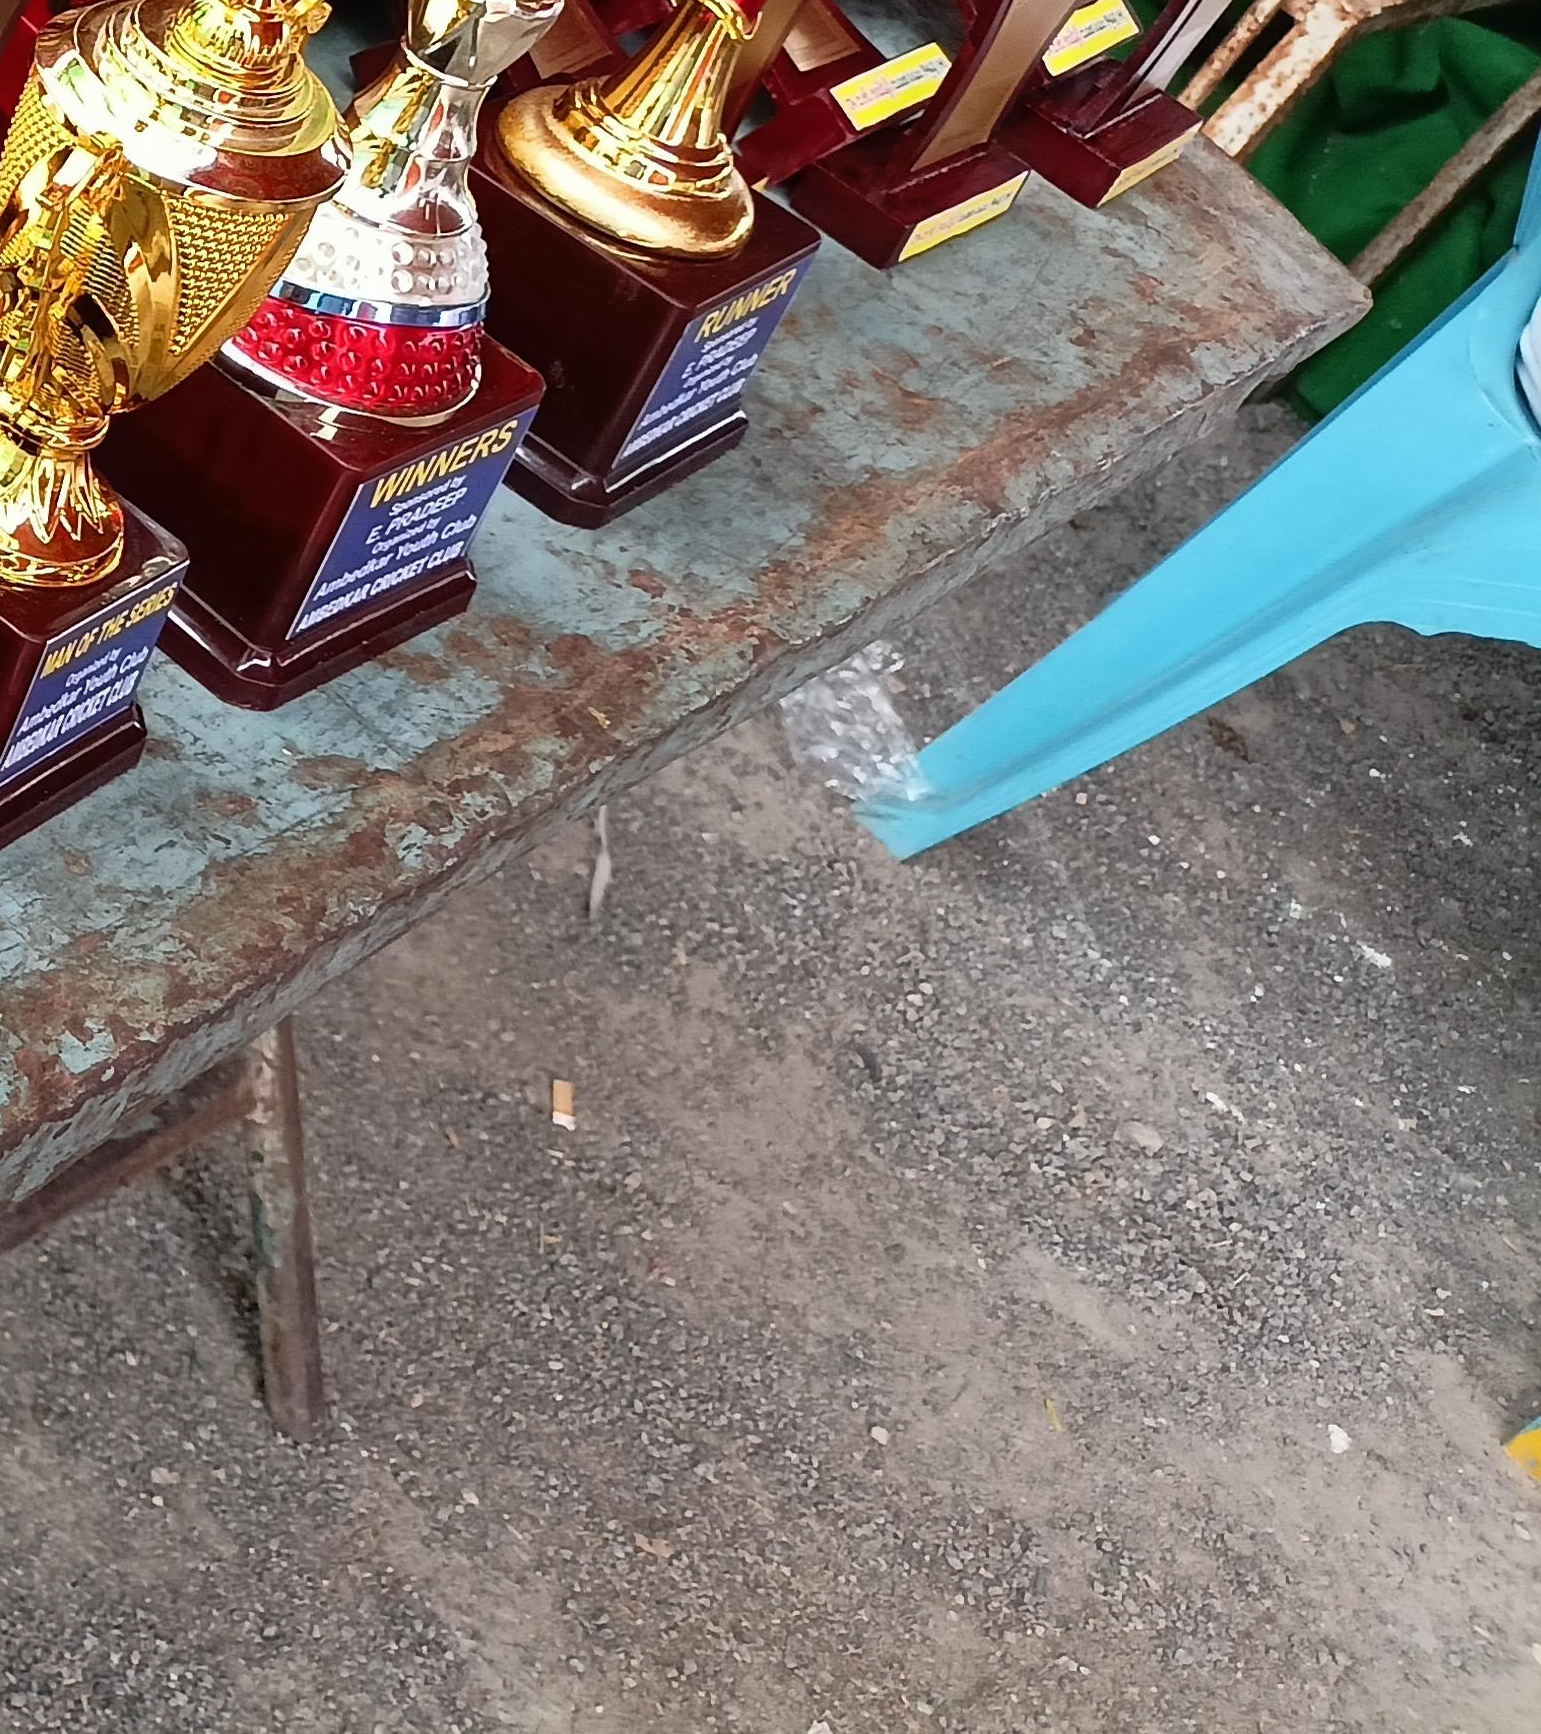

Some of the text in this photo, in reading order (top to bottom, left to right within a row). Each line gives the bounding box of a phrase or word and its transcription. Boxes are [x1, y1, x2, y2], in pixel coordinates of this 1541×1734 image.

[694, 268, 797, 343] RUNNER
[370, 419, 518, 508] WINNERS
[384, 487, 467, 536] PRADEEP
[389, 474, 466, 516] Sponsored by
[426, 517, 442, 532] by
[312, 514, 477, 601] Ambedkar Youth Club
[370, 558, 429, 596] CRICKET
[427, 541, 465, 570] CLUB
[40, 582, 178, 679] MAN OF THE SERIES
[120, 646, 149, 673] Club
